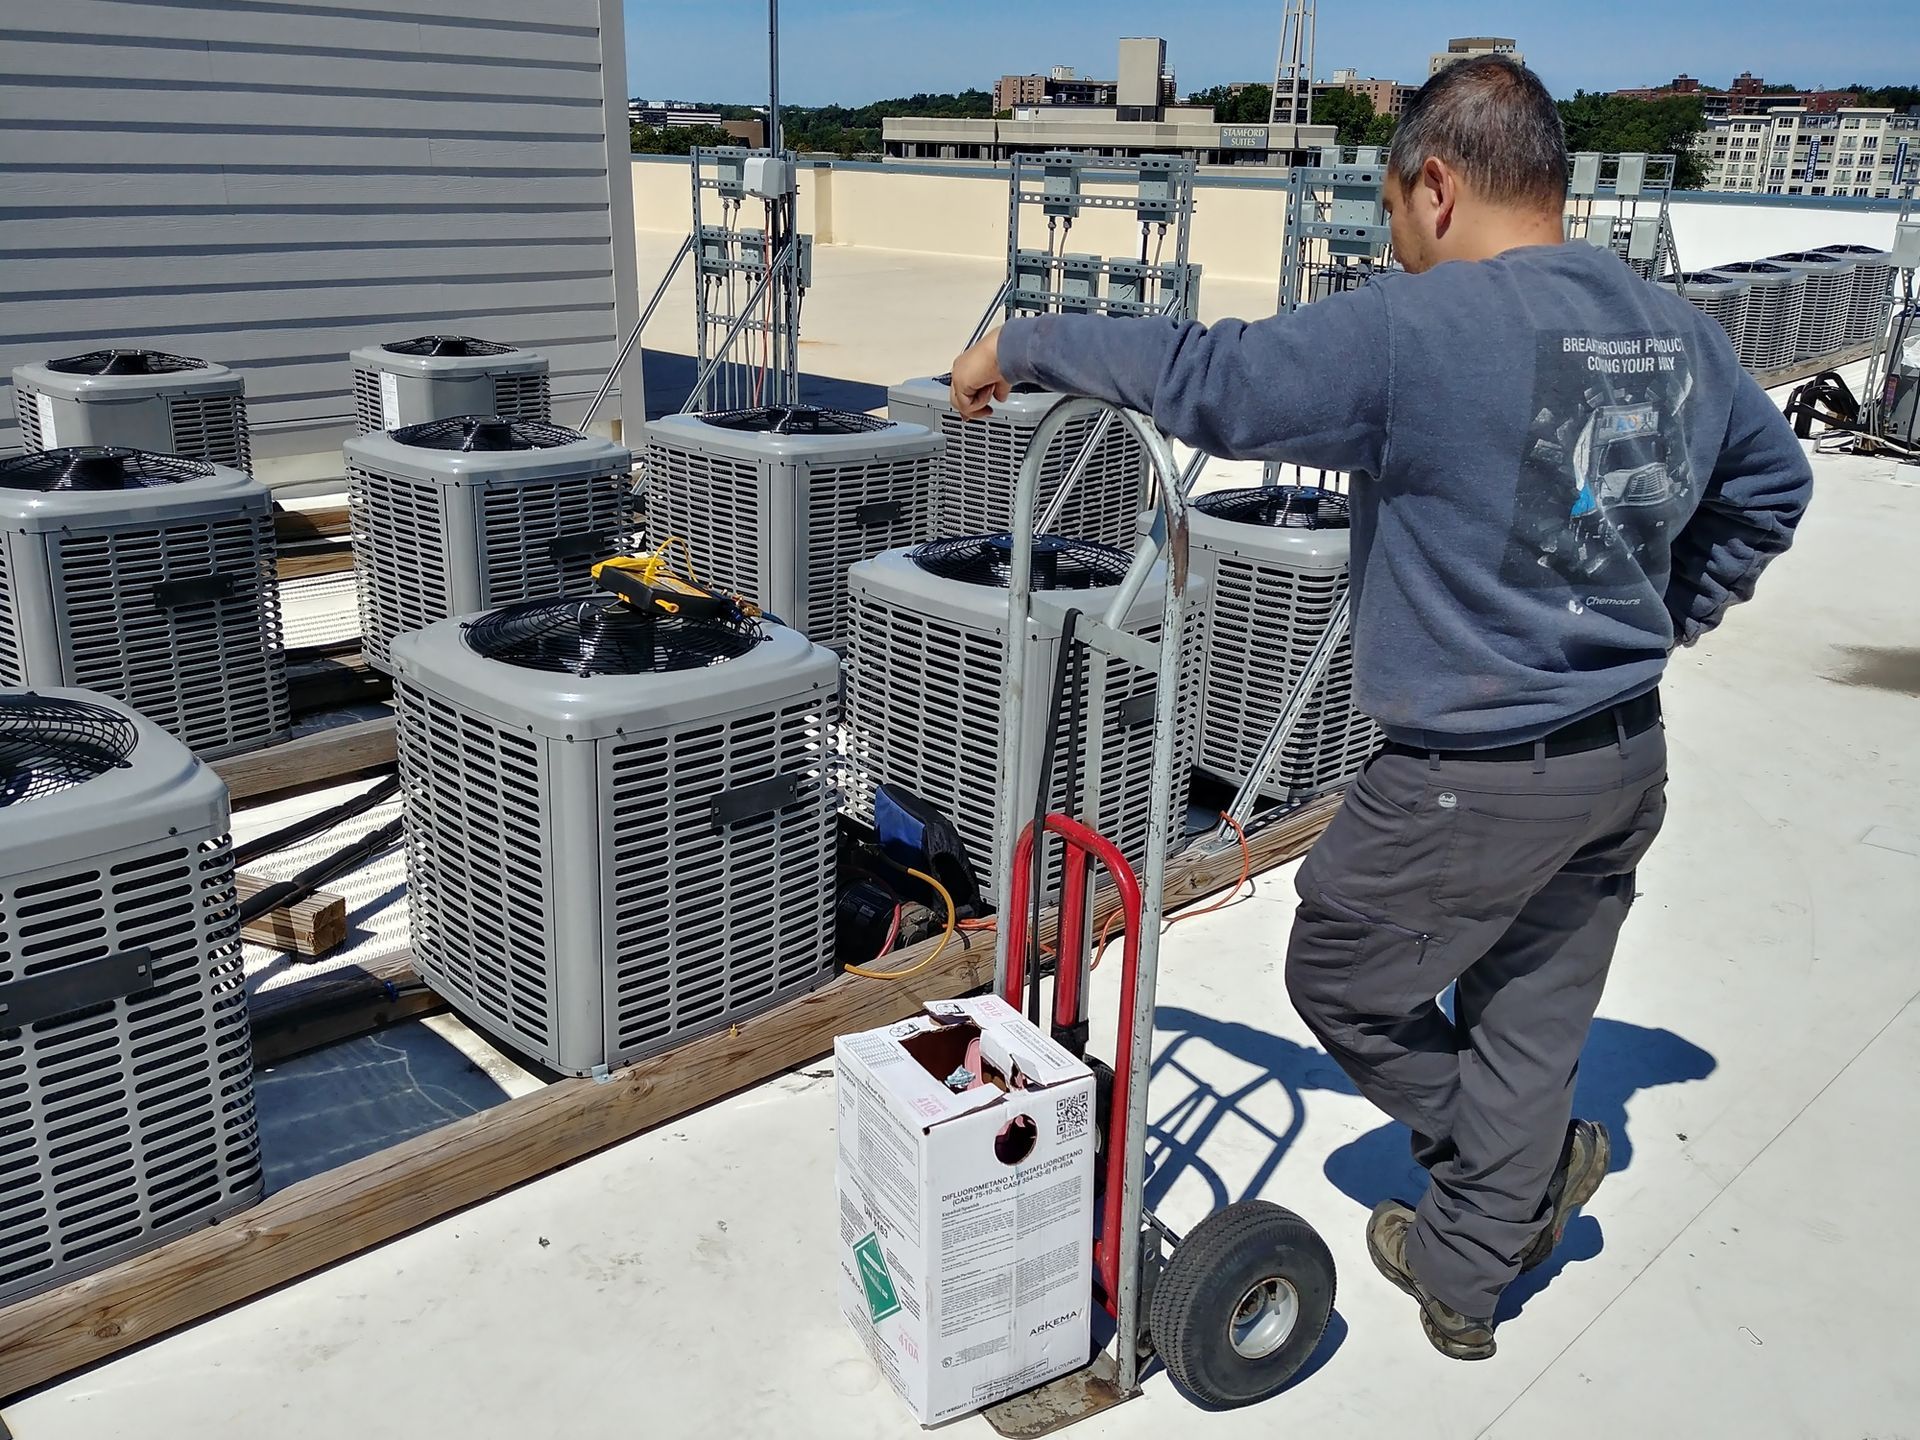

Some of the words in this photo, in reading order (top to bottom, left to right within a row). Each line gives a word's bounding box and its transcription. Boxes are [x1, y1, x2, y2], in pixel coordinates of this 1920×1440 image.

[1223, 128, 1265, 137] STAMFORD
[1231, 137, 1256, 146] SUITES
[1621, 357, 1654, 373] YOUR
[1585, 596, 1641, 606] Chemours
[1061, 1128, 1083, 1141] R-410A
[1052, 1159, 1074, 1172] R-410A
[941, 1176, 1008, 1202] DIFLUOROMETANO
[1009, 1174, 1015, 1182] Y
[1016, 1148, 1083, 1180] PENTAFLUOROETANO
[1029, 1310, 1078, 1338] ARKEMA
